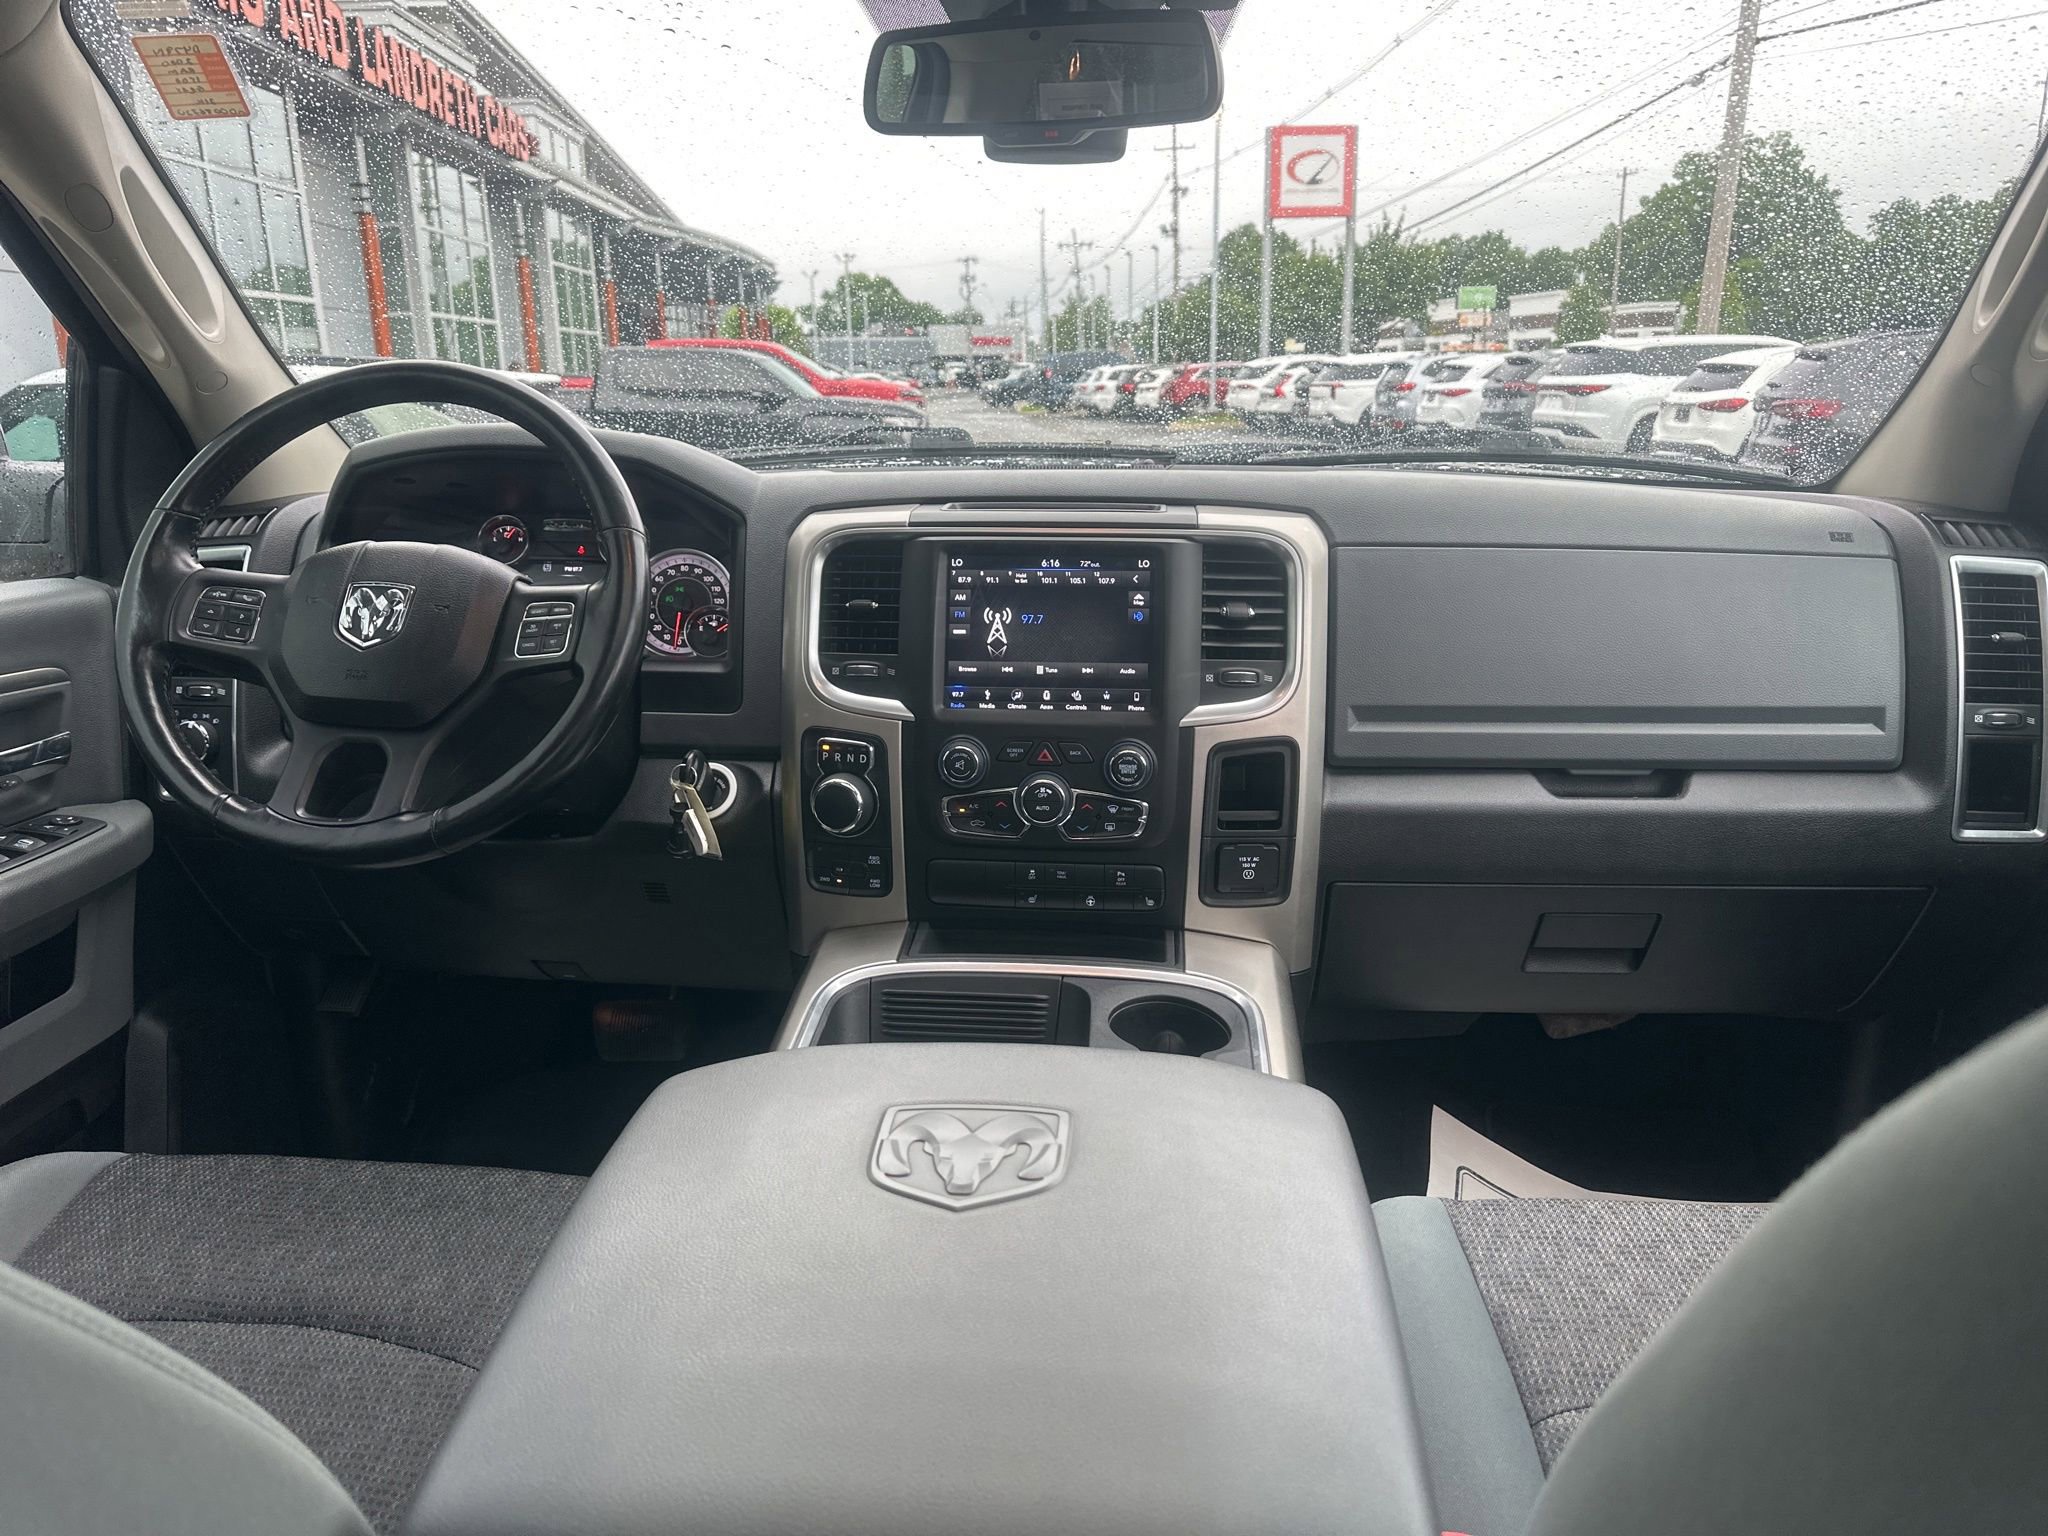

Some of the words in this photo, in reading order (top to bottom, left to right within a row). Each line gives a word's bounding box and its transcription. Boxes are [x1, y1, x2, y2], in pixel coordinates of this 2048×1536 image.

[280, 0, 350, 70] AND
[356, 16, 482, 139] LANDRETH
[484, 94, 531, 162] CARS
[951, 558, 963, 567] LO
[1041, 559, 1060, 568] 6:16
[1138, 559, 1150, 568] LO
[654, 575, 664, 583] 60
[957, 576, 972, 584] 87.9
[1098, 577, 1116, 585] 107.9
[954, 593, 967, 601] AM
[1021, 614, 1044, 624] 97.7
